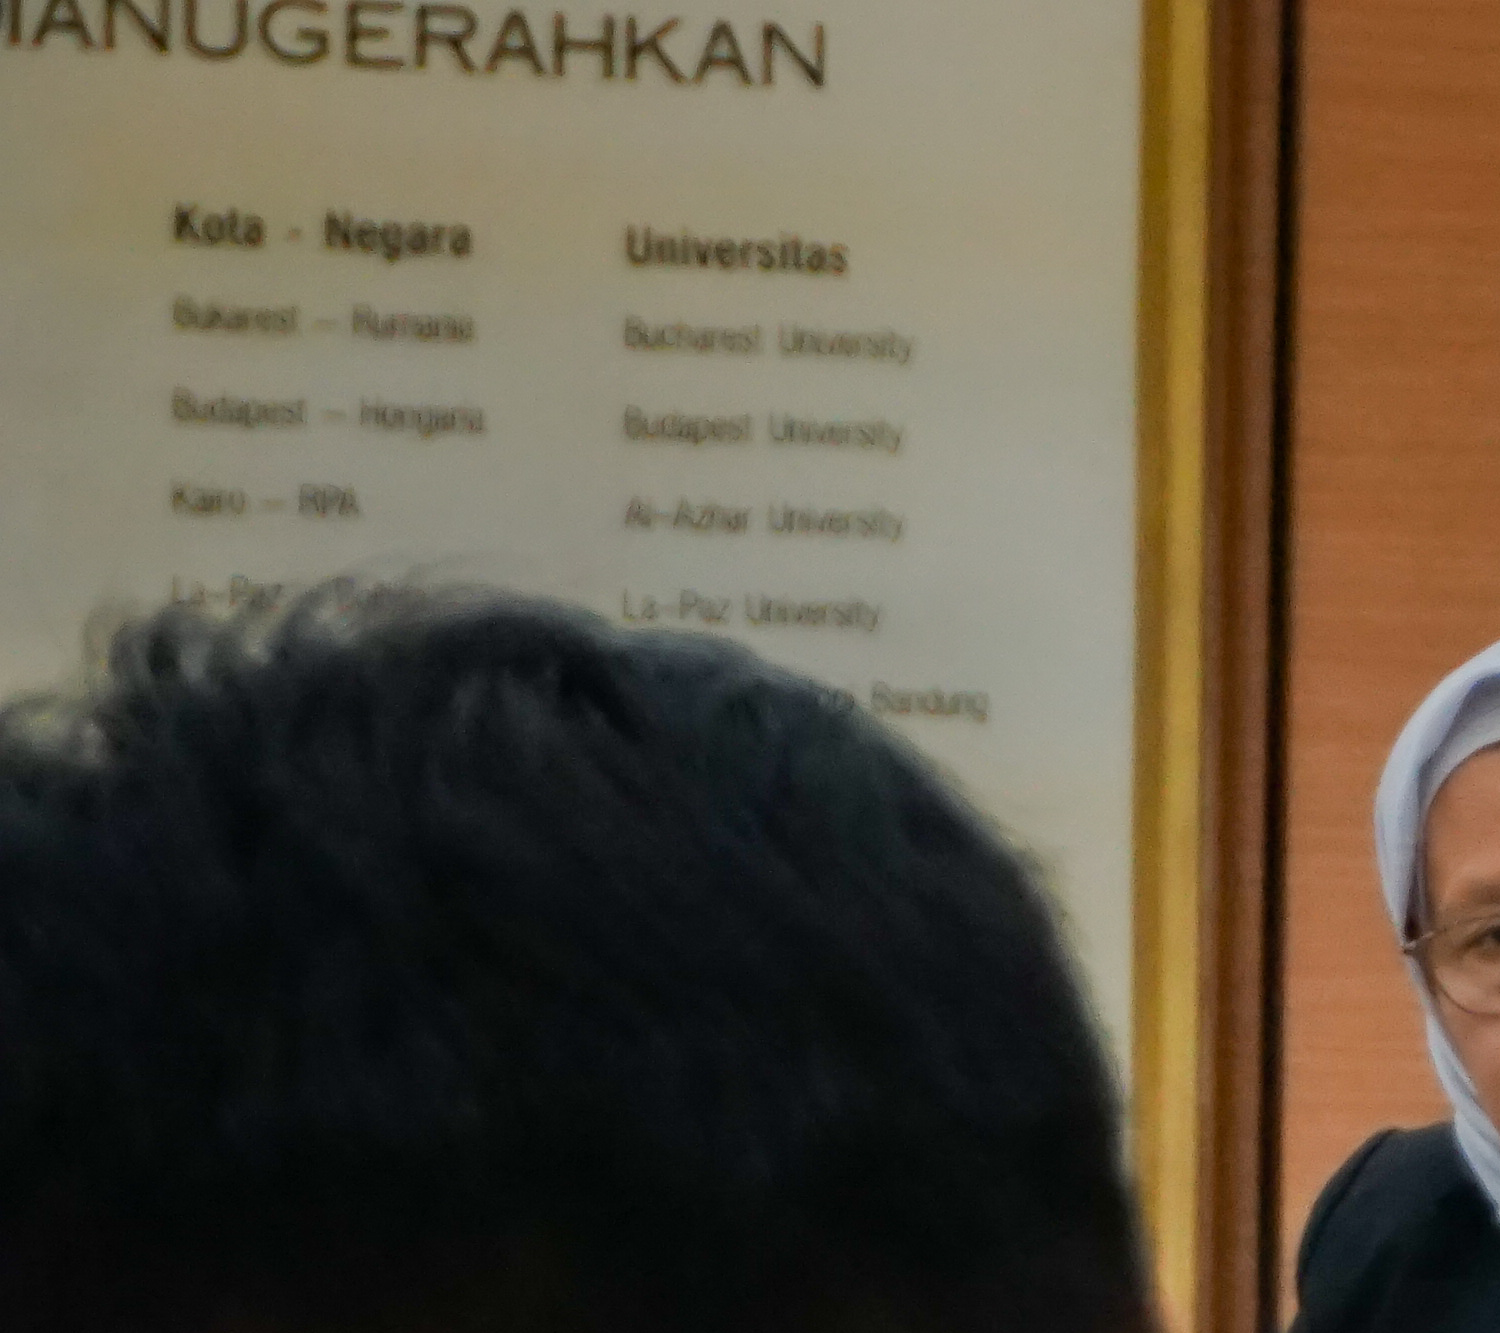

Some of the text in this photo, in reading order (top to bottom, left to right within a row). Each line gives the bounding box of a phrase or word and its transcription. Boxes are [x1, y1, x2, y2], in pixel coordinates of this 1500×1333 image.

[173, 204, 265, 248] Kota
[325, 209, 472, 262] Negara
[625, 223, 850, 276] Universitas
[623, 316, 913, 366] Bucharest University
[769, 411, 903, 456] University
[768, 502, 904, 545] University
[745, 592, 882, 633] University
[870, 680, 989, 725] Bandung
